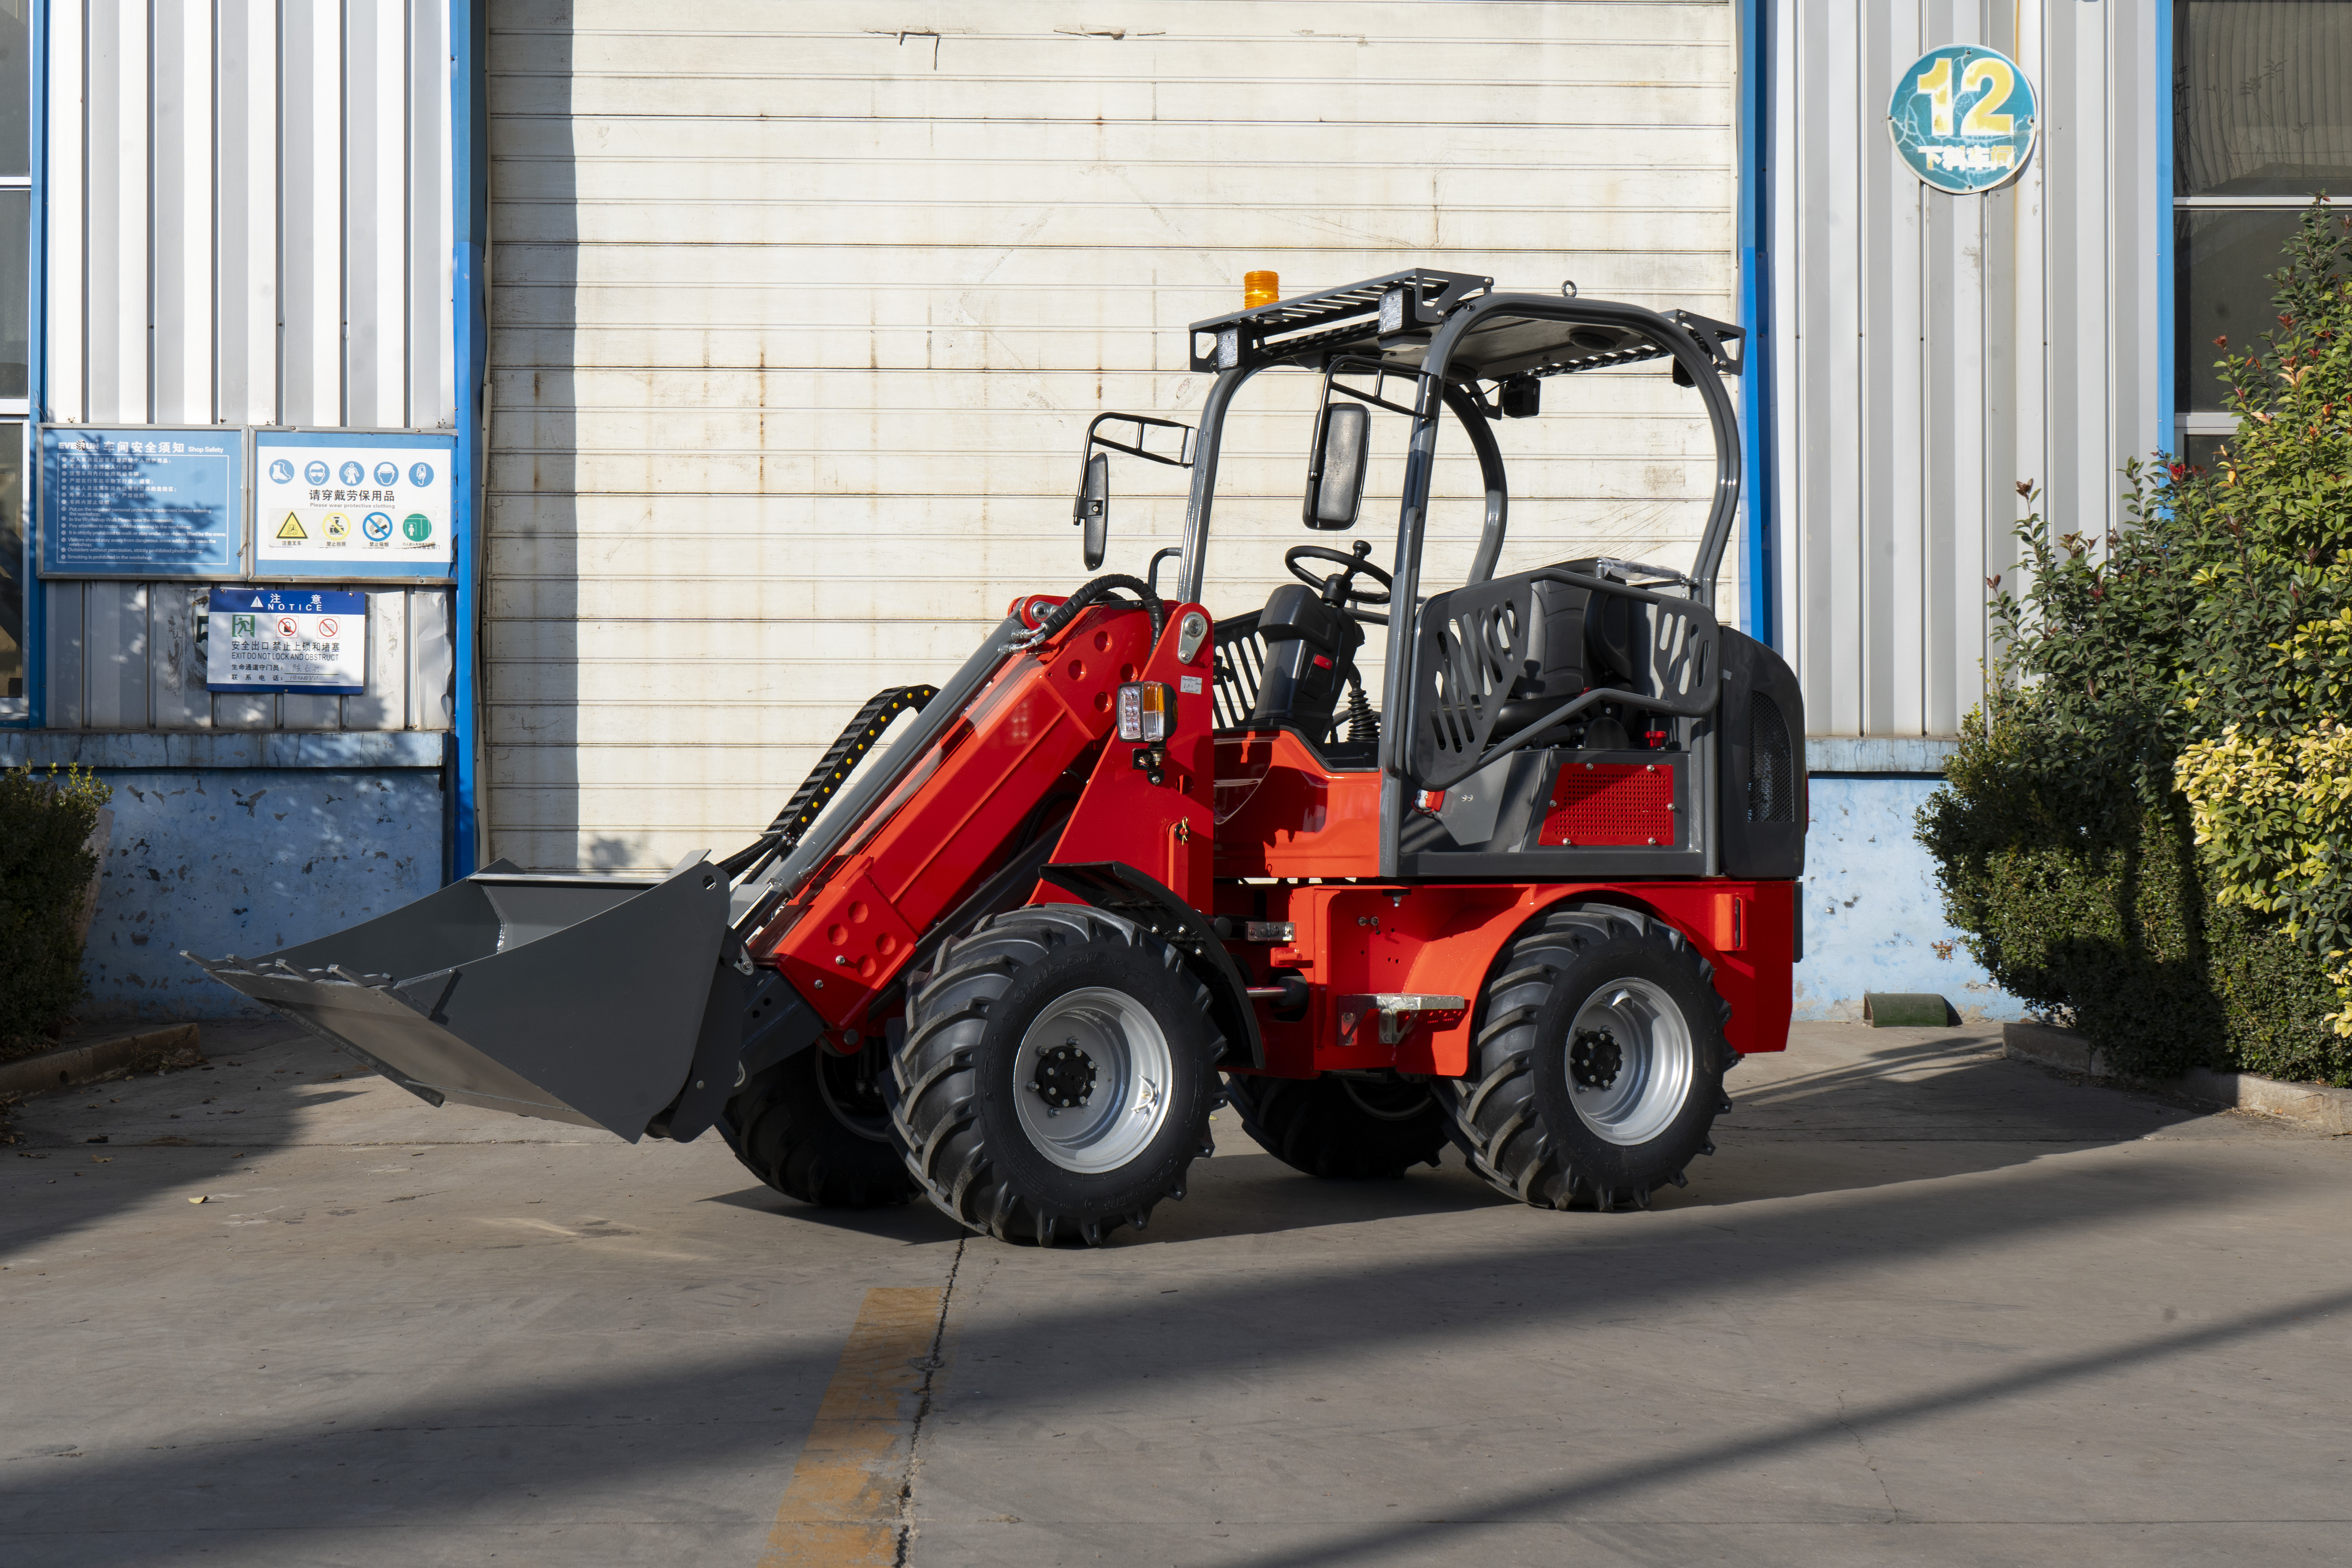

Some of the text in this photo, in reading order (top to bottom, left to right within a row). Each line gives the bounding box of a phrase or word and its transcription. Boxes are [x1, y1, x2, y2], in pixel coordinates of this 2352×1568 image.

[1917, 57, 2014, 136] 12
[103, 441, 184, 454] 车间安全须知
[309, 489, 395, 501] 请穿戴劳保用品
[231, 641, 340, 652] 安全出口 禁止上锁和堵塞
